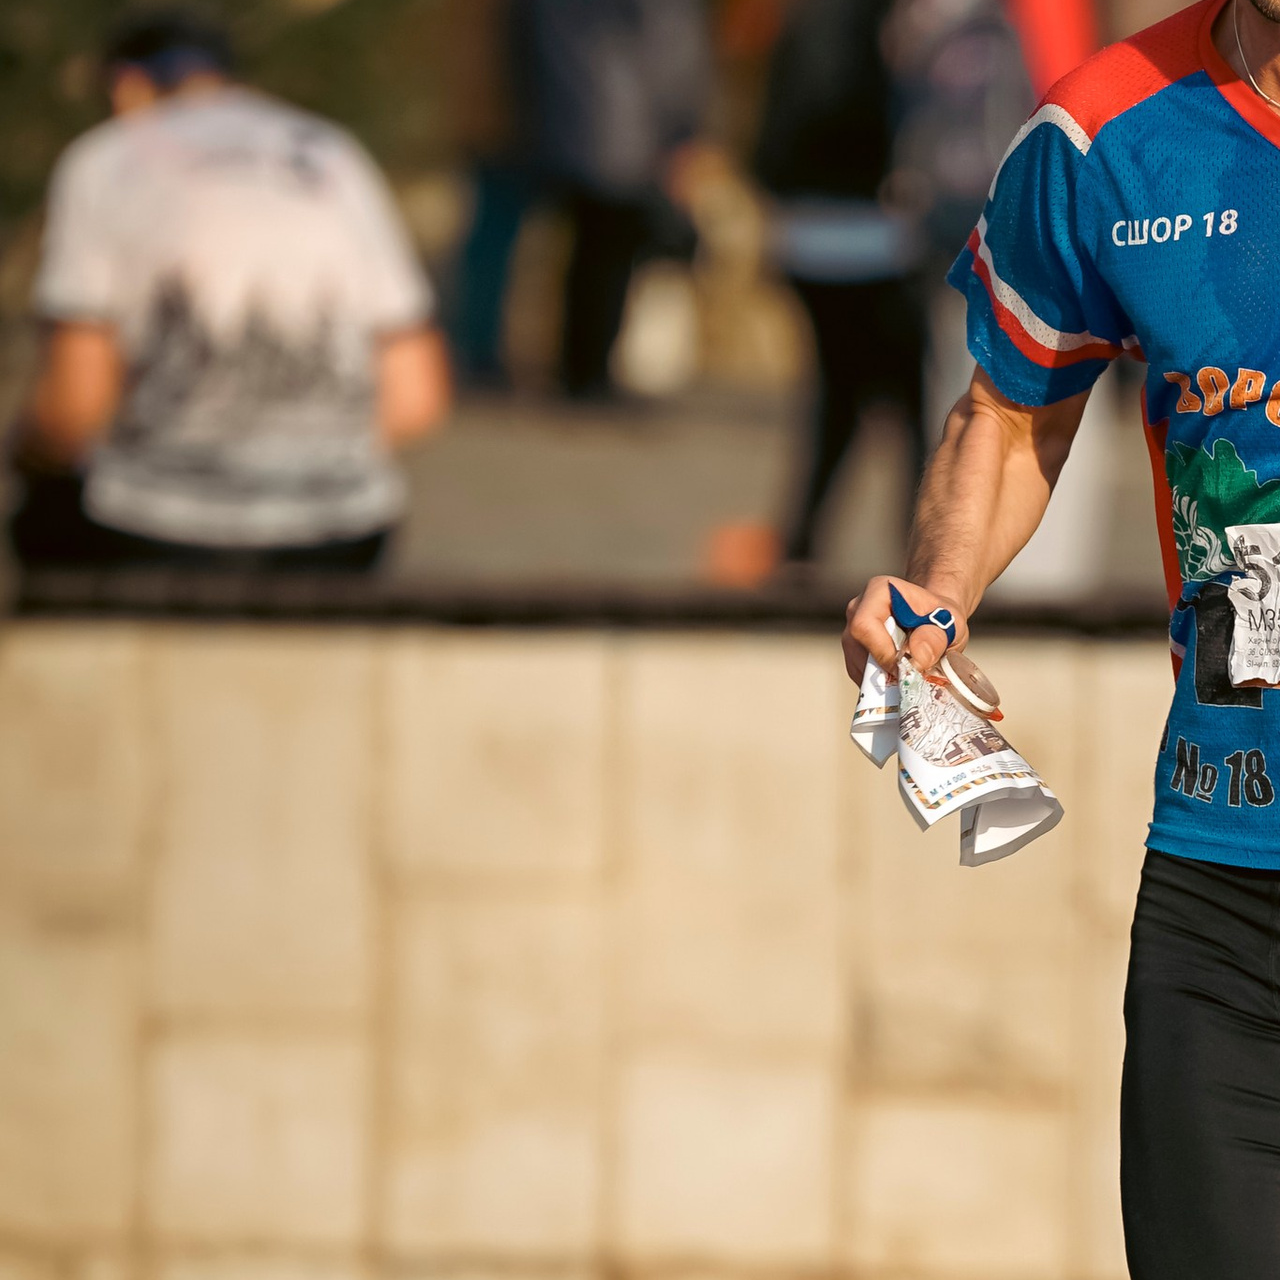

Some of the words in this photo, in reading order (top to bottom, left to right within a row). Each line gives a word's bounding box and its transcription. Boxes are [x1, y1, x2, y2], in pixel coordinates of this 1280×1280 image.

[1111, 214, 1193, 246] СШОР
[1202, 208, 1239, 237] 18
[1224, 748, 1275, 808] 18
